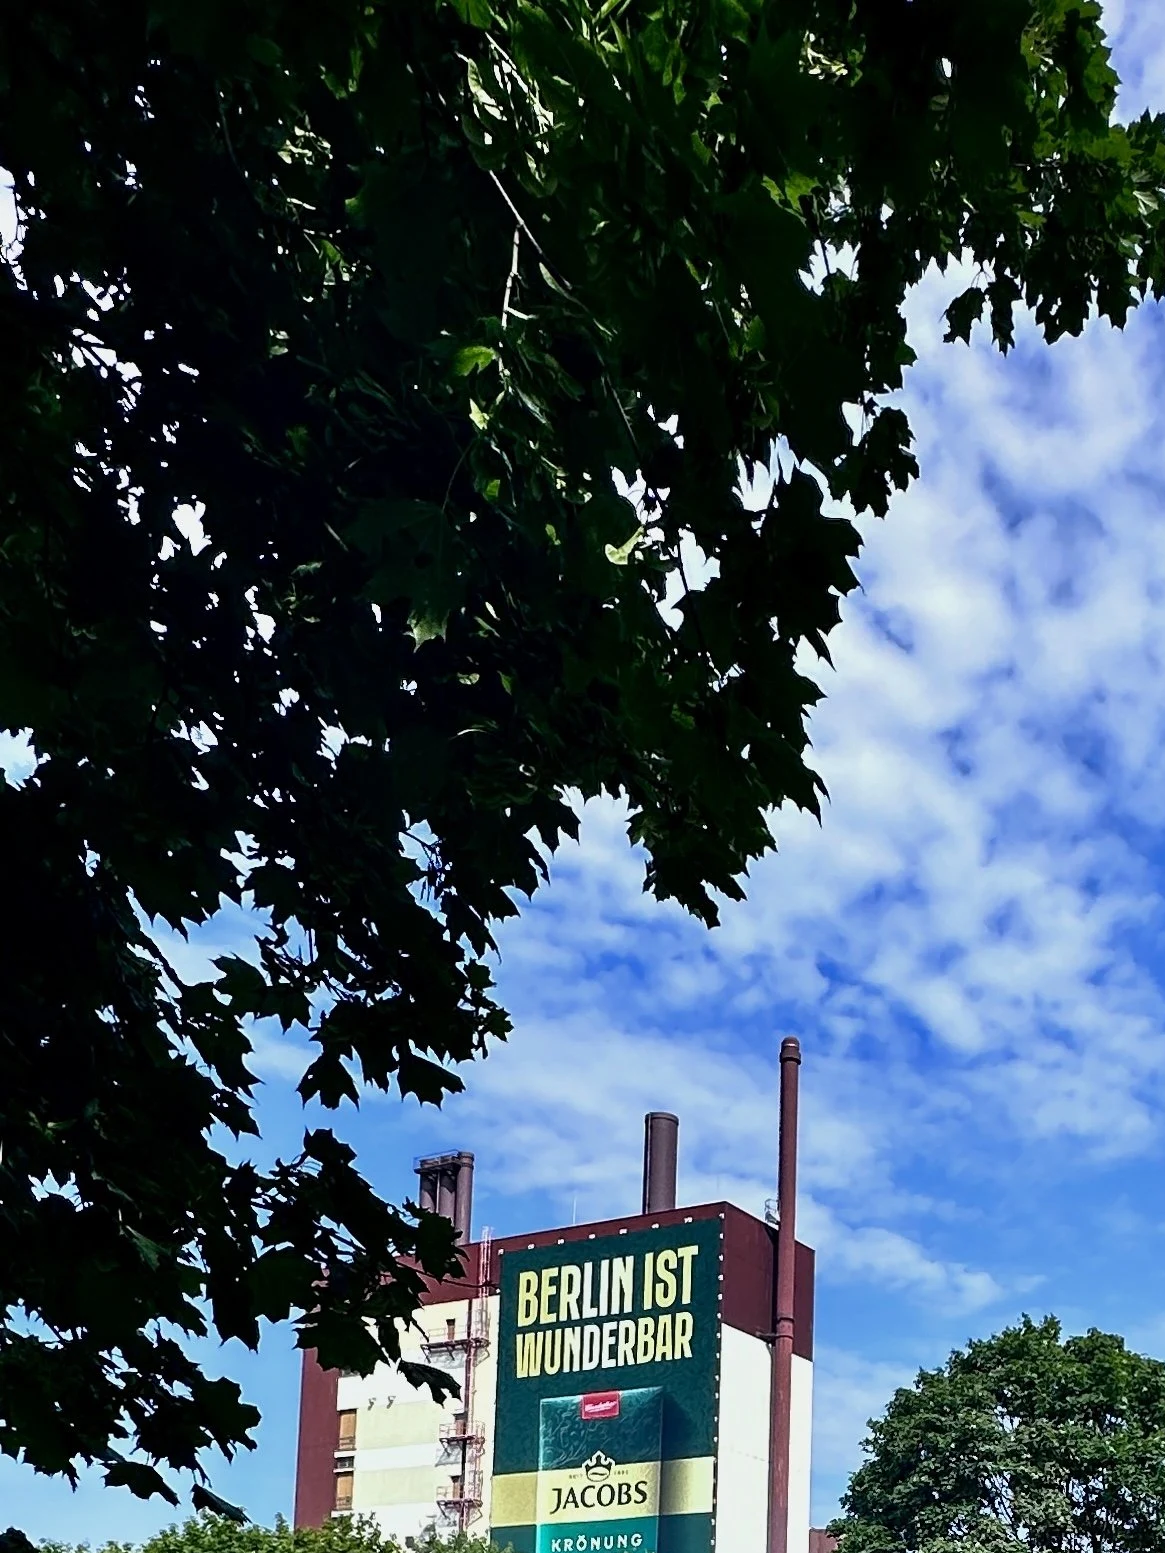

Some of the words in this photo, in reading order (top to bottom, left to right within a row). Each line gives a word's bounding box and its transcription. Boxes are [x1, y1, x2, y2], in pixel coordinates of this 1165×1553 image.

[518, 1255, 635, 1328] BERLIN
[643, 1245, 699, 1311] IST
[516, 1311, 694, 1379] WUNDERBAR
[550, 1481, 648, 1515] JACOBS
[551, 1533, 643, 1552] KRÖNUNG
